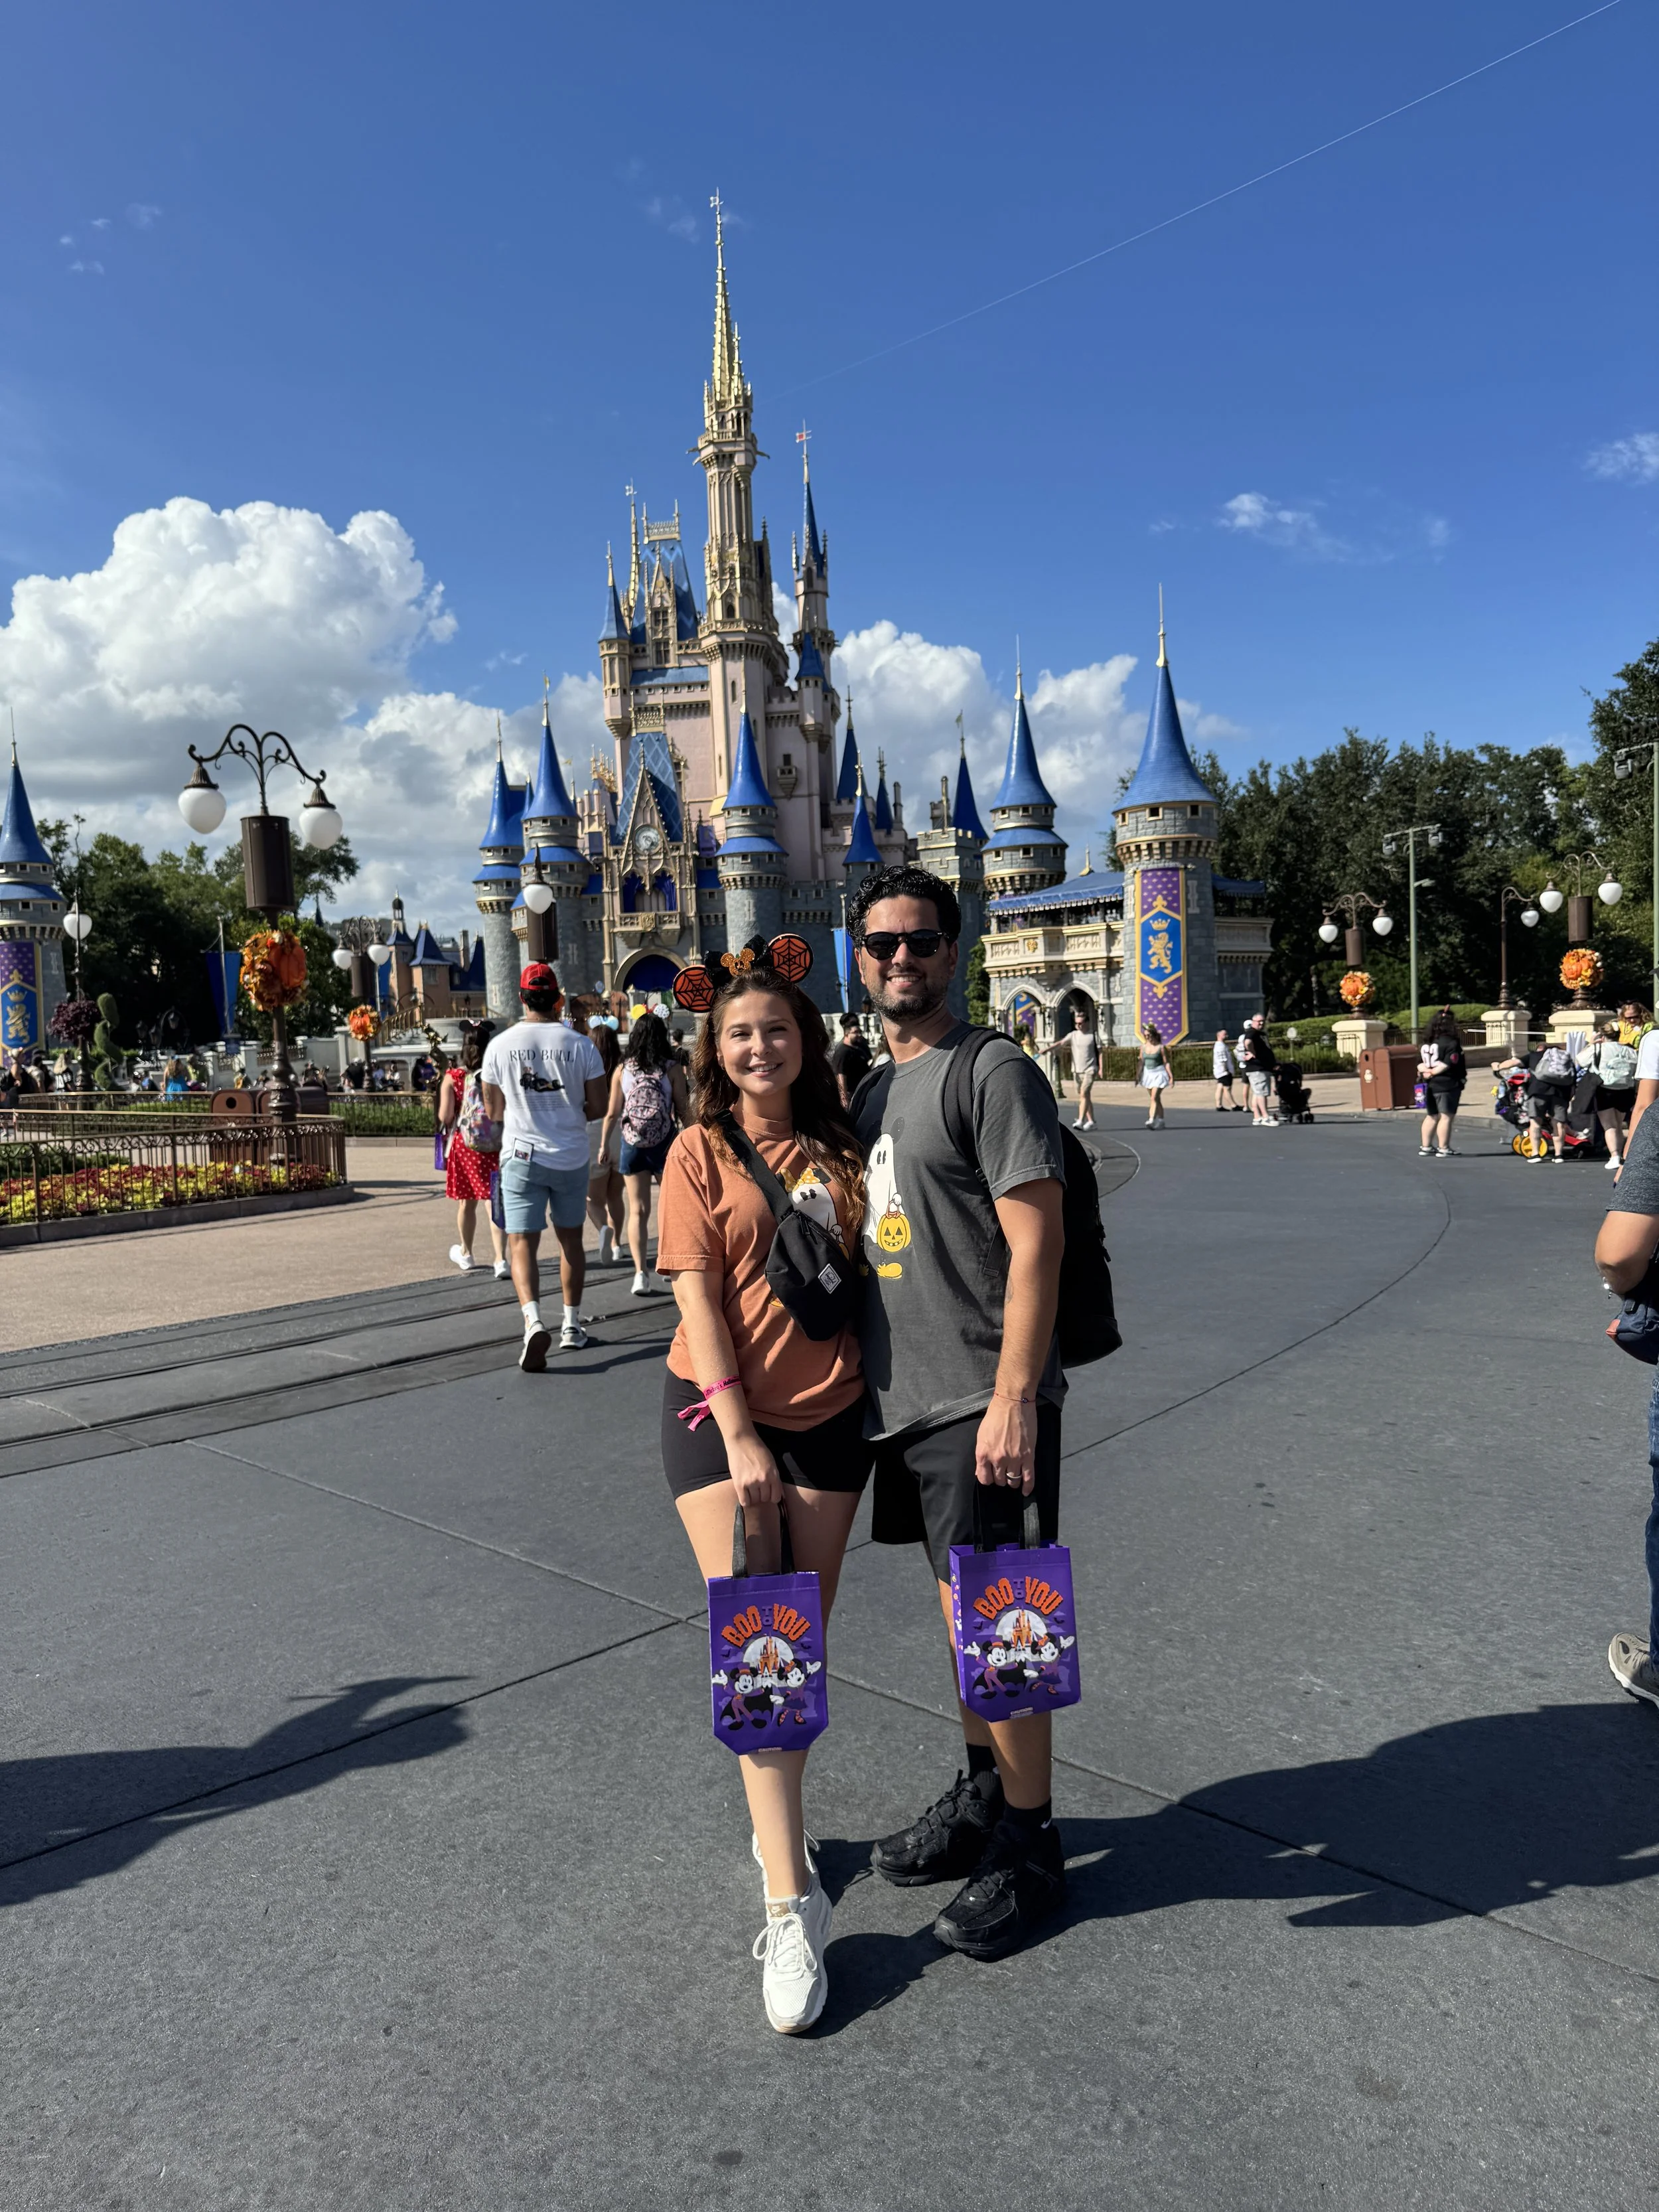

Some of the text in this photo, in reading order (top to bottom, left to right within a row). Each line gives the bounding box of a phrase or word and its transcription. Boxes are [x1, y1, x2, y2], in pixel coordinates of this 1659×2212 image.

[510, 1049, 575, 1062] RED BULL
[1421, 1043, 1439, 1068] 62
[973, 1576, 1064, 1620] BOO TO YOU
[721, 1603, 811, 1648] BOO TO YOU
